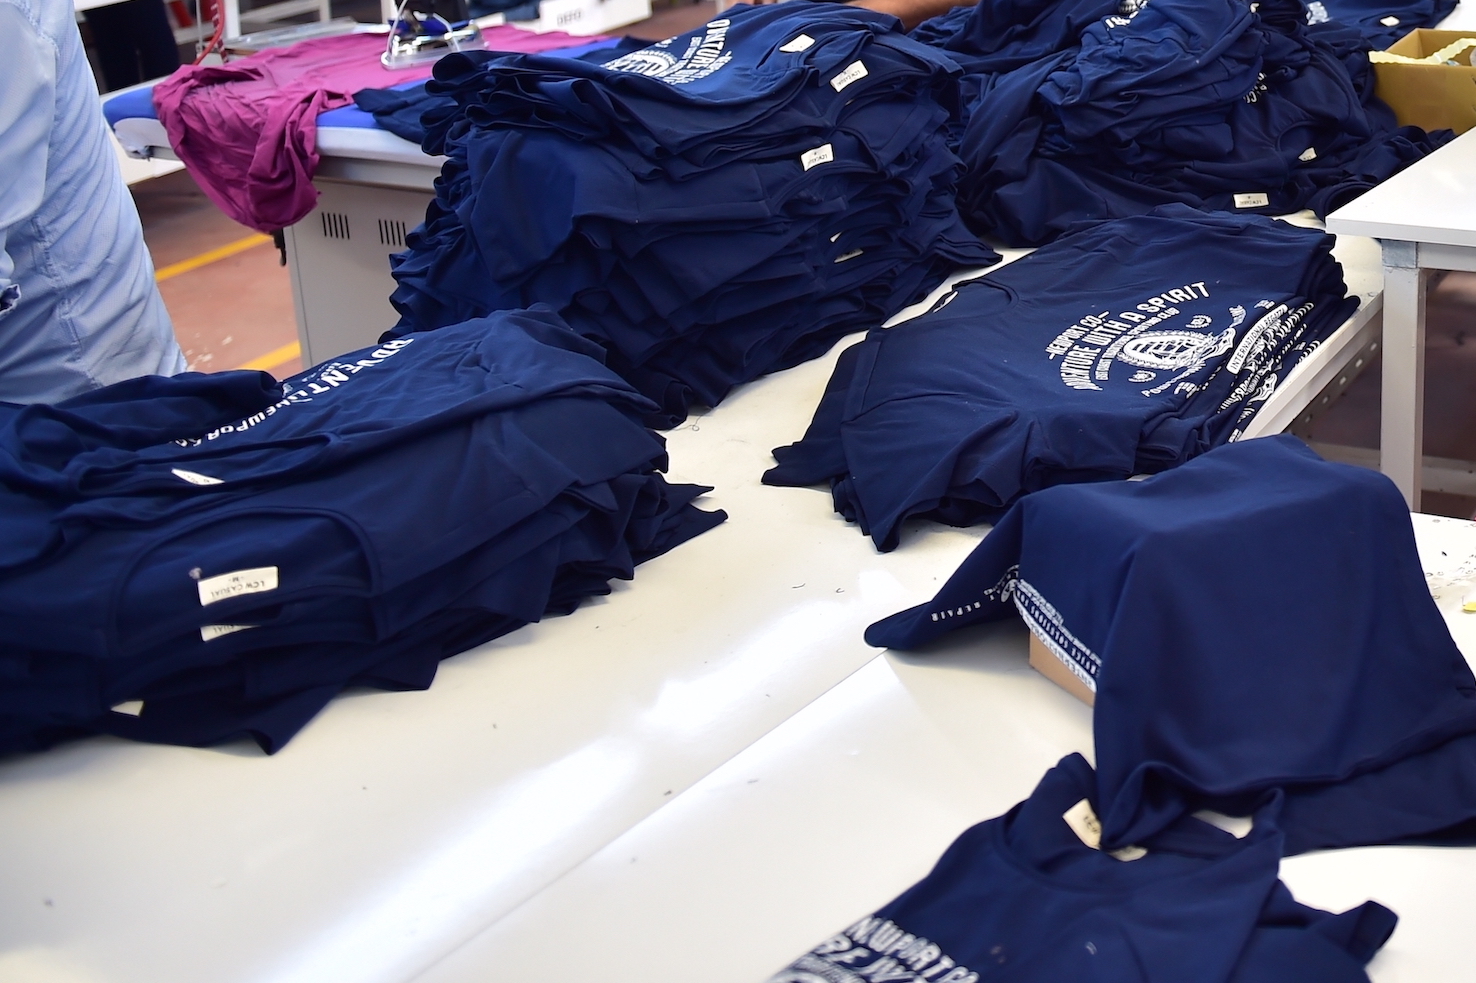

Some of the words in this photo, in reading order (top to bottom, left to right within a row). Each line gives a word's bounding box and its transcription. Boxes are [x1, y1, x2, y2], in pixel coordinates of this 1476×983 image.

[1081, 319, 1132, 346] WITH
[1119, 311, 1147, 323] A
[1136, 281, 1210, 314] SPIRIT
[931, 601, 982, 622] REPAIR
